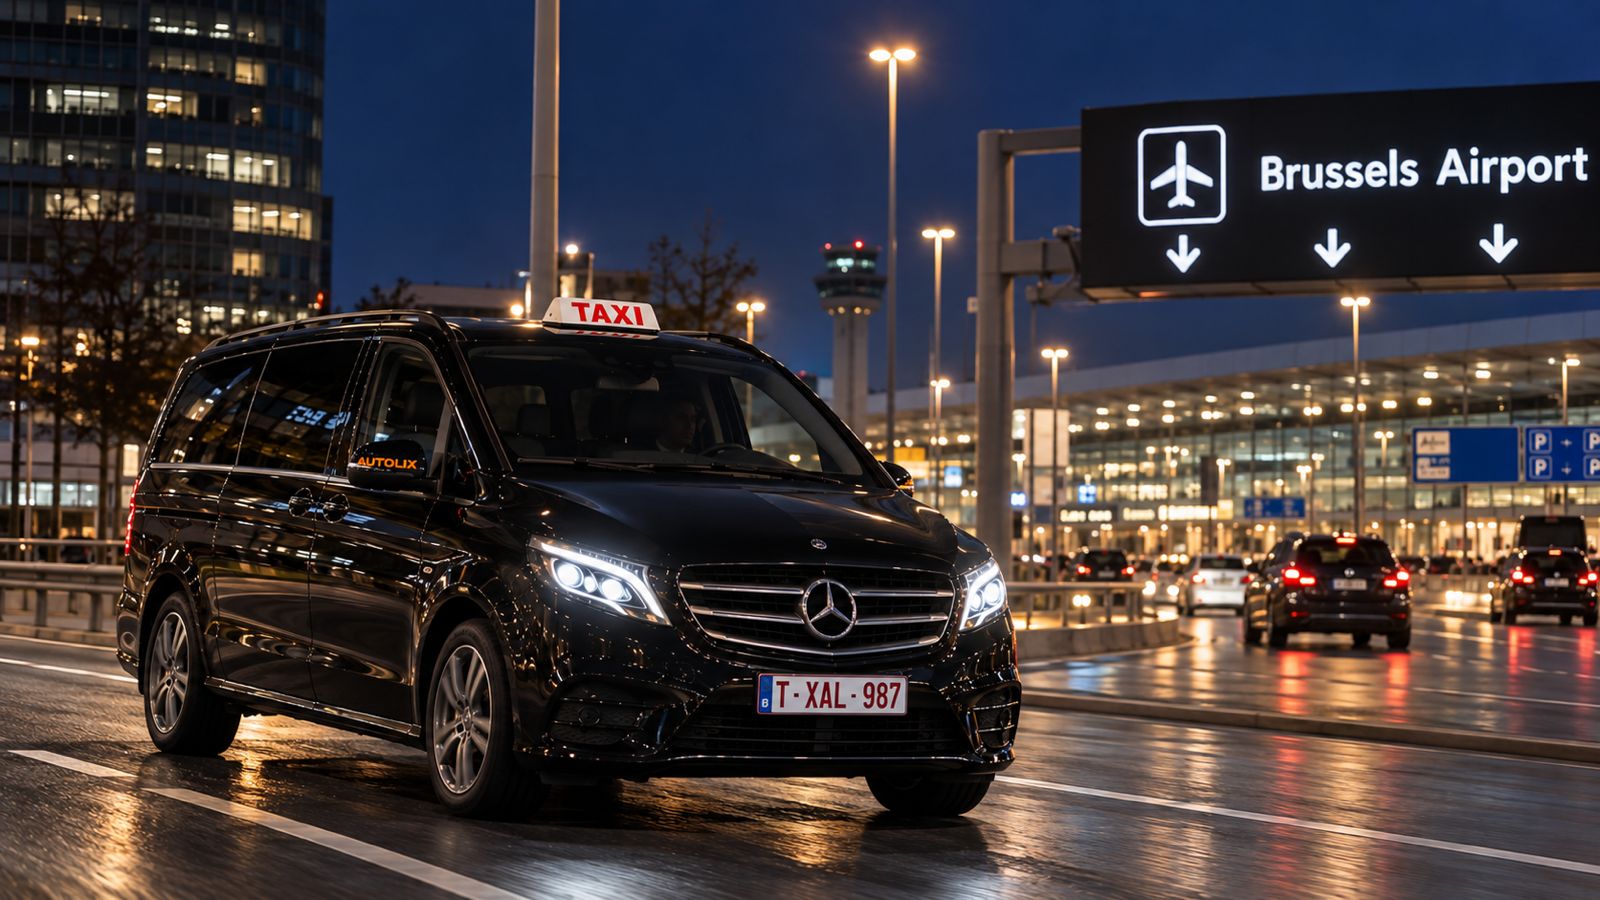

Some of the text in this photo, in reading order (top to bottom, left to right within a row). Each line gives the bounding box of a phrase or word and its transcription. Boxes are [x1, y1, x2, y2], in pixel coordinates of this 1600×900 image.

[1260, 147, 1589, 194] Brussels Airport
[571, 301, 644, 326] TAXI
[1535, 433, 1547, 450] P
[357, 456, 418, 470] AUTOLIX
[1535, 459, 1547, 476] P
[761, 698, 769, 708] B
